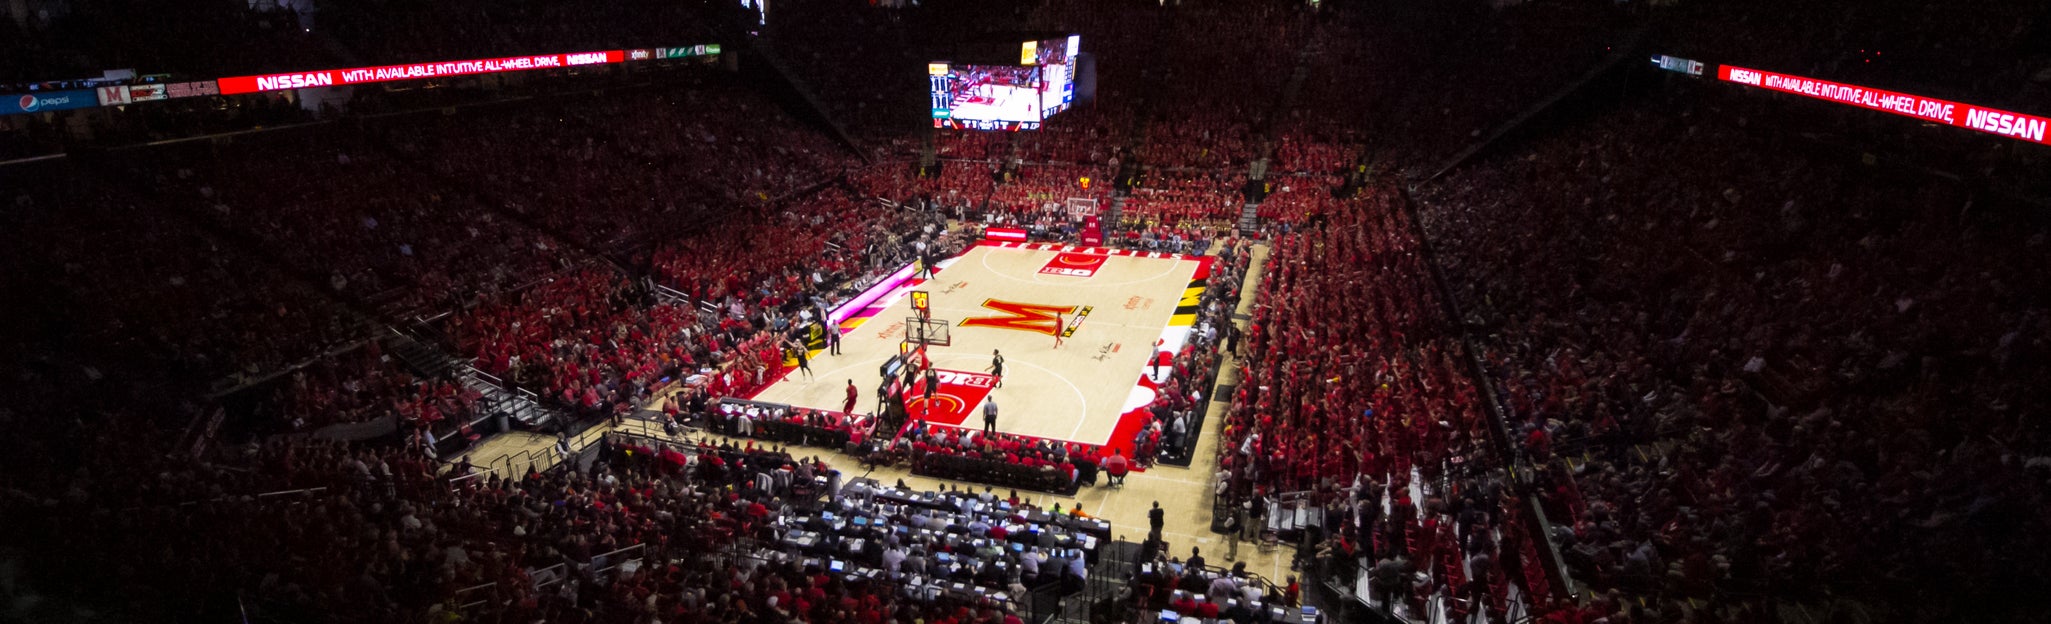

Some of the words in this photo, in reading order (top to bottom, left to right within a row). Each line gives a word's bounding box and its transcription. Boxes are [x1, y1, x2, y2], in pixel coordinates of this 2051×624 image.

[257, 72, 333, 91] NISSAN
[342, 69, 374, 83] WITH
[376, 64, 434, 80] AVAILABLE
[436, 61, 484, 75] INTUITIVE
[485, 58, 533, 71] ALL-WHEEL
[566, 52, 607, 65] NISSAN
[40, 95, 70, 109] pepsi
[104, 86, 124, 105] M
[1730, 68, 1762, 86] NISSAN
[1765, 75, 1782, 88] WITH
[1782, 77, 1820, 96] AVAILABLE
[1821, 83, 1862, 104] INTUITIVE
[1862, 90, 1916, 115] ALL-WHEEL
[1965, 108, 2047, 141] NISSAN
[1000, 242, 1182, 260] TERRAPINS
[957, 298, 1078, 336] M
